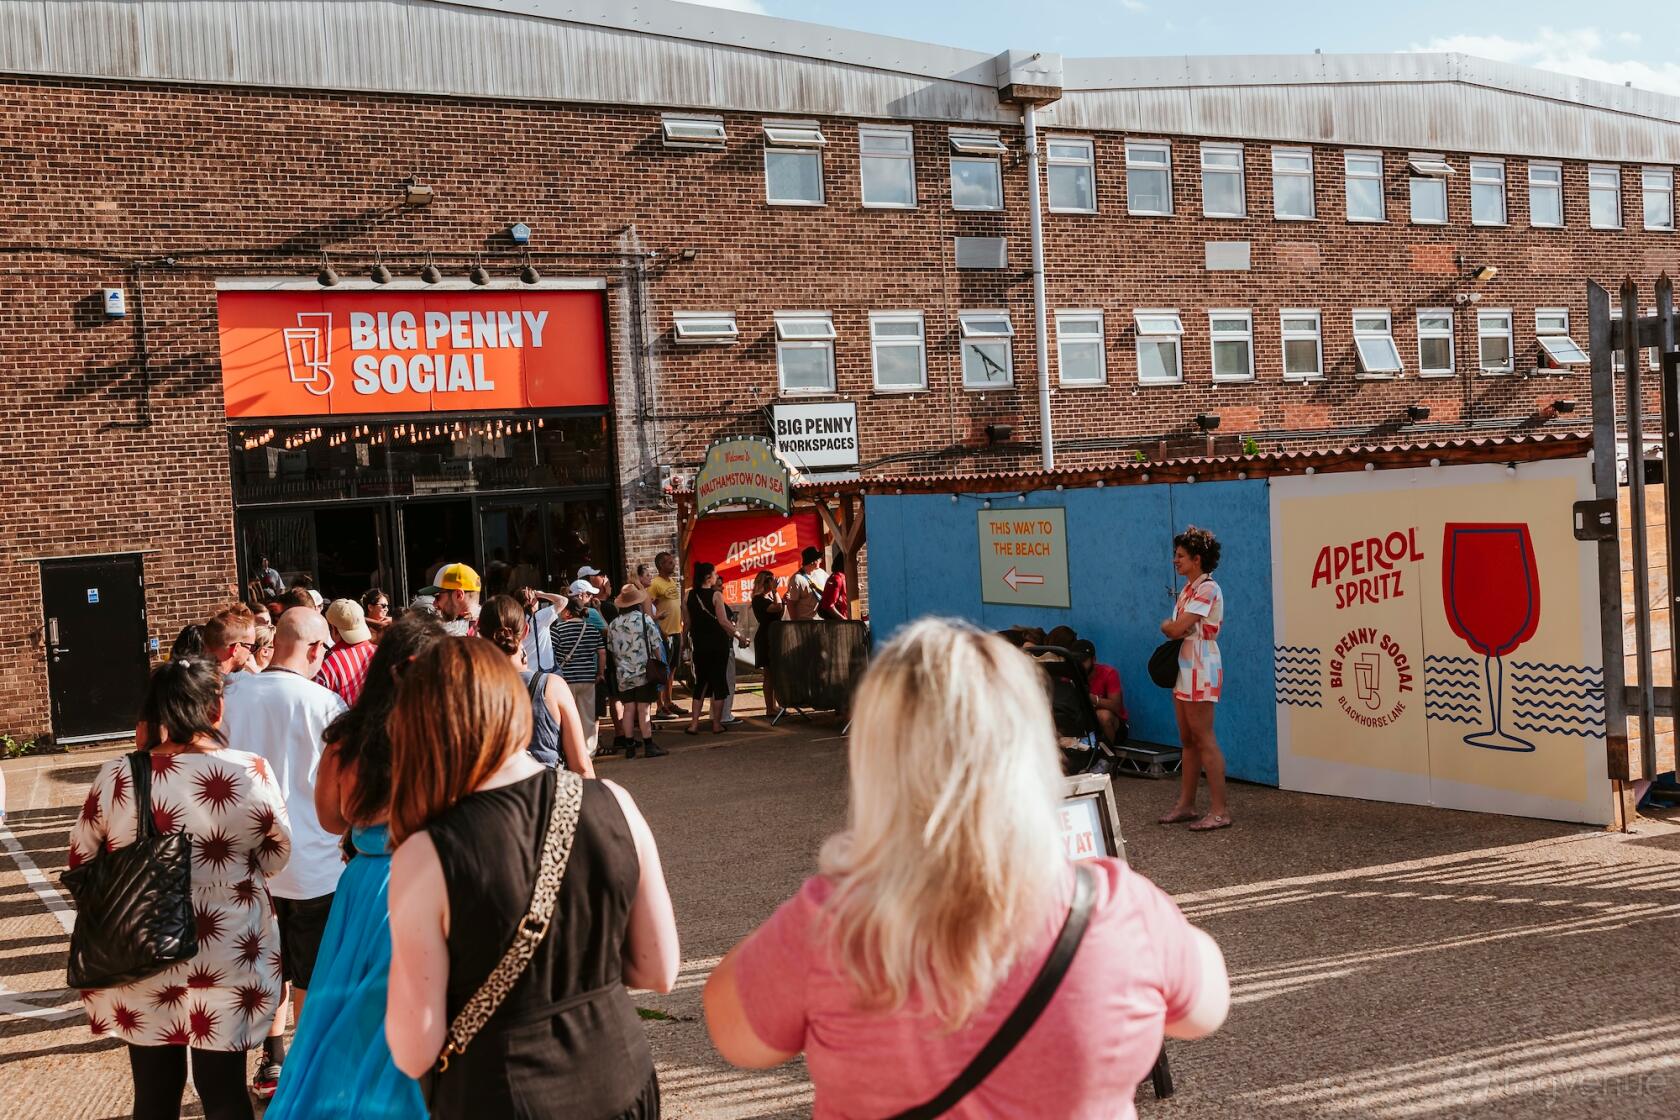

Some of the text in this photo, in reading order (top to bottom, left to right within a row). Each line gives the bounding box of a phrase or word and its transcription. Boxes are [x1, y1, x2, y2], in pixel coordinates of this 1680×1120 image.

[350, 310, 549, 350] BIG PENNY
[353, 354, 495, 395] SOCIAL
[777, 416, 854, 436] BIG PENNY
[778, 437, 855, 453] WORKSPACES
[700, 471, 785, 498] WALTHAMSTOW ON SEA
[989, 520, 1053, 535] THIS WAY TO
[726, 530, 787, 564] APEROL
[740, 550, 777, 573] SPRITZ
[993, 542, 1050, 556] THE BEACH
[1311, 527, 1424, 589] APEROL
[1335, 570, 1404, 610] SPRITZ
[1329, 627, 1413, 693] BIG PENNY SOCIAL
[1338, 695, 1406, 729] BLACKHORSE LANE
[1076, 831, 1093, 854] AT
